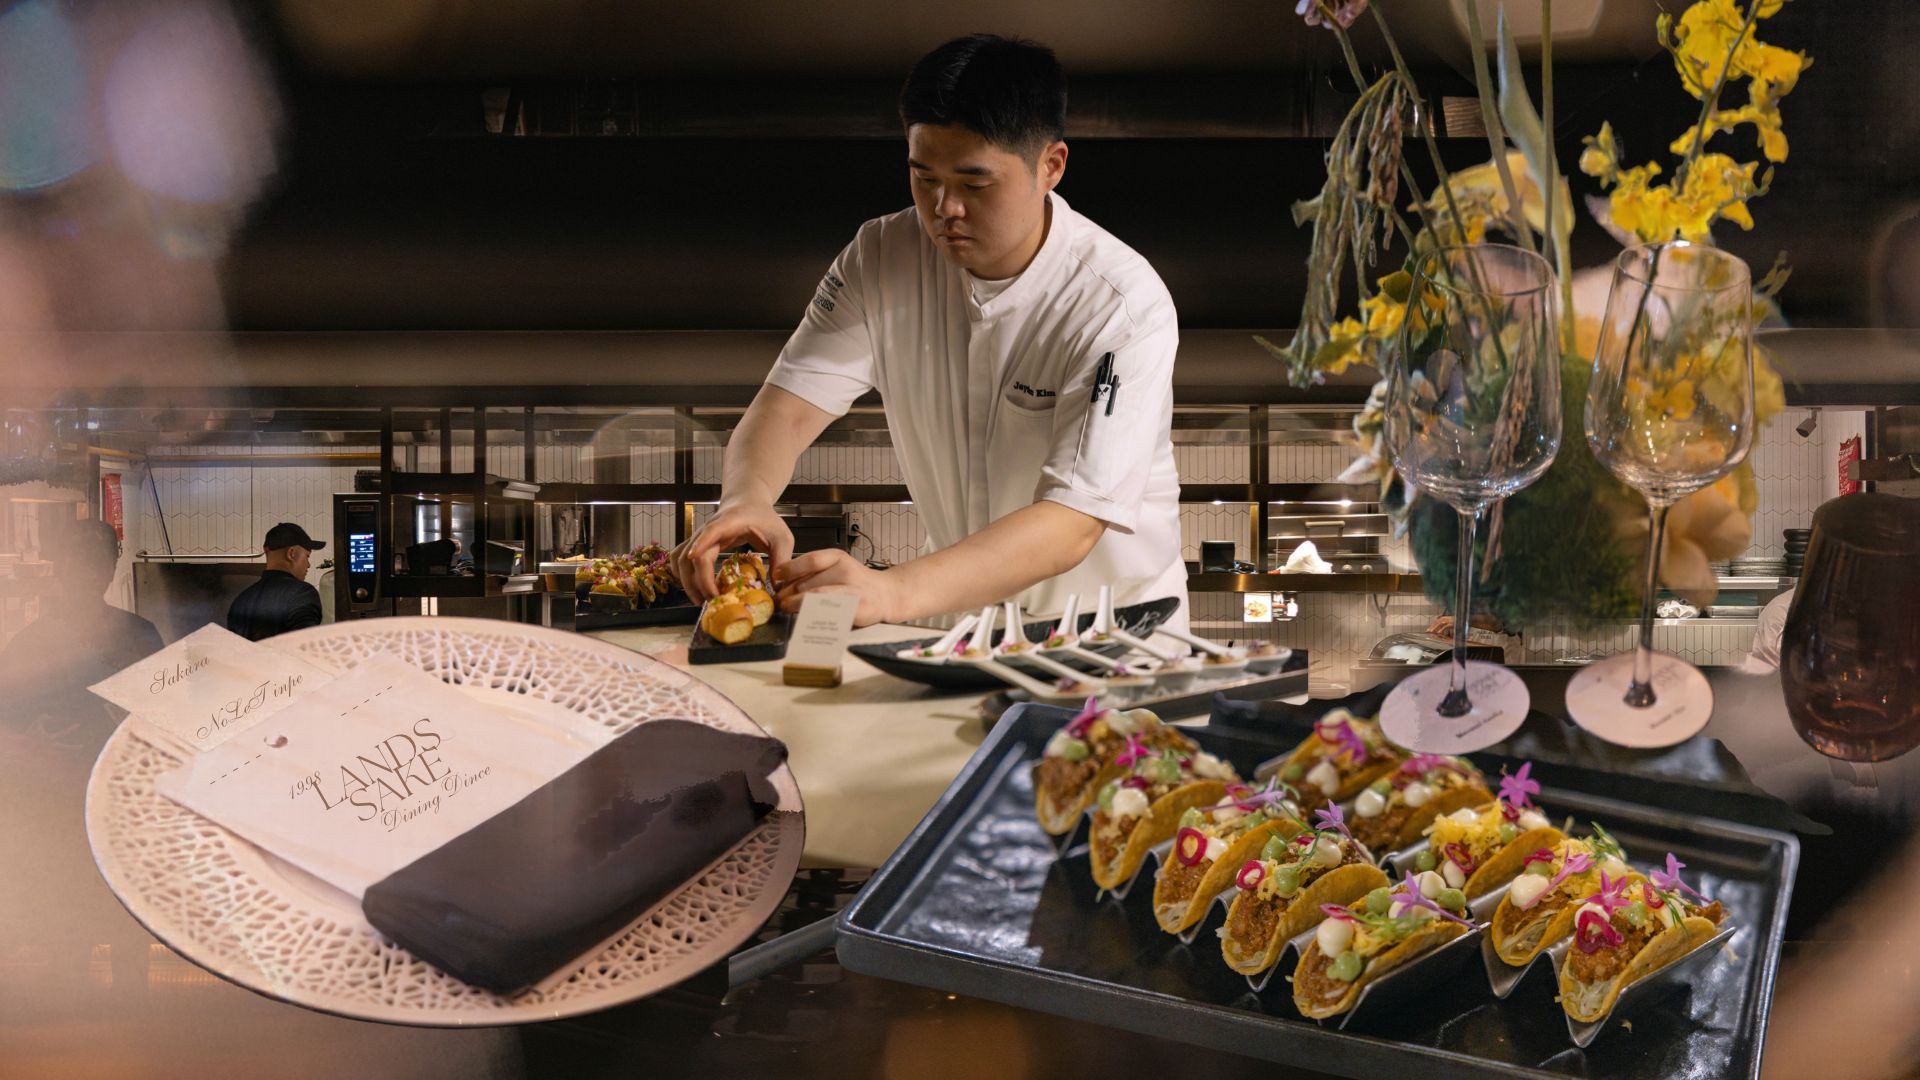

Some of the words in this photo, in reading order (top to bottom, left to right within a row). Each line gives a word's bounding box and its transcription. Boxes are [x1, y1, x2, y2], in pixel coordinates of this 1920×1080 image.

[150, 656, 209, 694] Sakura
[311, 718, 440, 810] LANDS
[350, 746, 451, 821] SAKE
[381, 793, 441, 832] Dining
